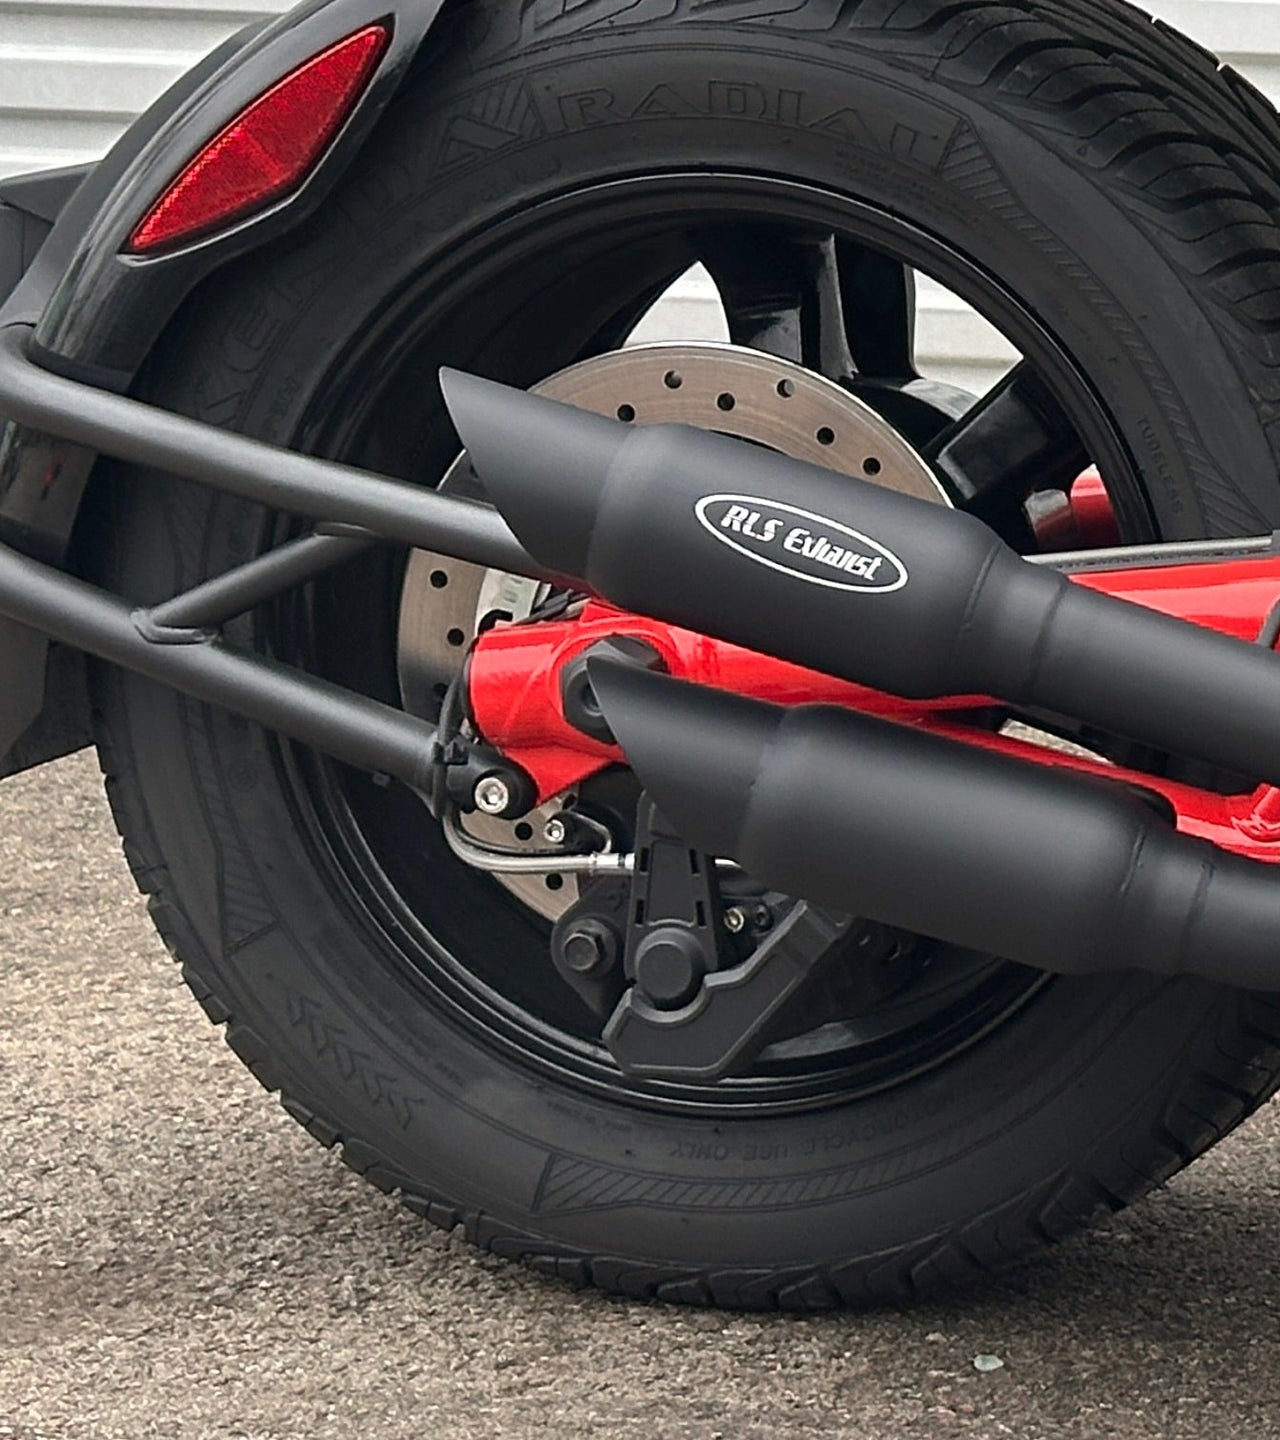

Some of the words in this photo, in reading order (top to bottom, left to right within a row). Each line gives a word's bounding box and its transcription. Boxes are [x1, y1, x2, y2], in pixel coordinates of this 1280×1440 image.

[556, 78, 938, 169] RADIAL
[720, 504, 784, 542] RLS
[783, 527, 882, 581] Exhaust
